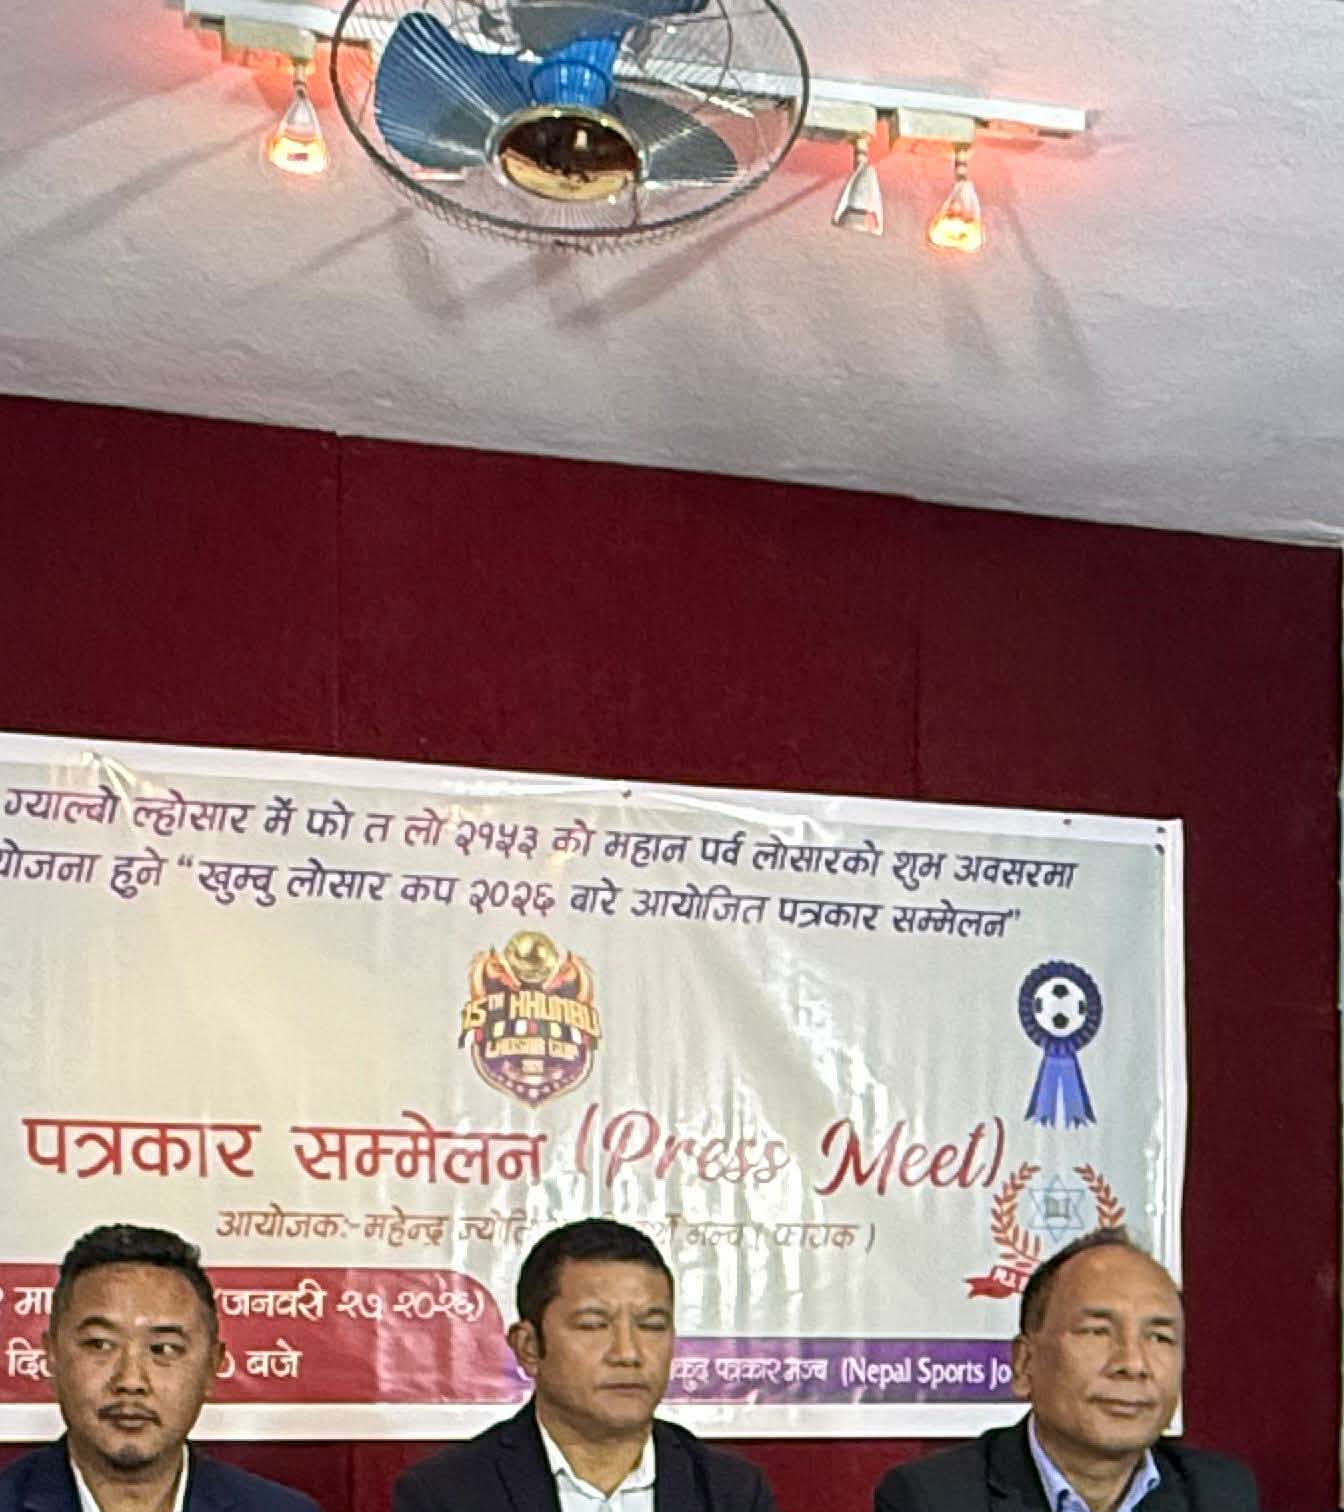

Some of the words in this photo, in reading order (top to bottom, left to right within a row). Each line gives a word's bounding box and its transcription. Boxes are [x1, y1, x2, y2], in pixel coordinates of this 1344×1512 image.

[134, 789, 256, 836] ल्होसार
[306, 800, 355, 843] फो
[365, 813, 394, 844] त
[405, 808, 448, 847] लो
[455, 819, 539, 857] २१५३
[552, 818, 595, 857] को
[604, 829, 690, 868] महान
[701, 831, 745, 867] पर्व
[752, 835, 883, 876] लोसारको
[892, 850, 946, 891] शुभ
[954, 854, 1079, 889] अवसरमा
[109, 847, 169, 899] हुने
[287, 857, 392, 901] लोसार
[400, 874, 459, 906] कप
[469, 878, 556, 917] २०२६
[631, 882, 771, 925] आयोजित
[779, 898, 889, 932] पत्रकार
[23, 1117, 261, 1178] पत्रकार
[291, 1110, 547, 1185] सम्मेलन
[576, 1102, 791, 1188] (Press
[814, 1115, 1005, 1196] Meet)
[13, 1285, 54, 1316] मा
[246, 1337, 304, 1379] बजे
[841, 1357, 911, 1389] (Nepal
[918, 1357, 986, 1389] Sports
